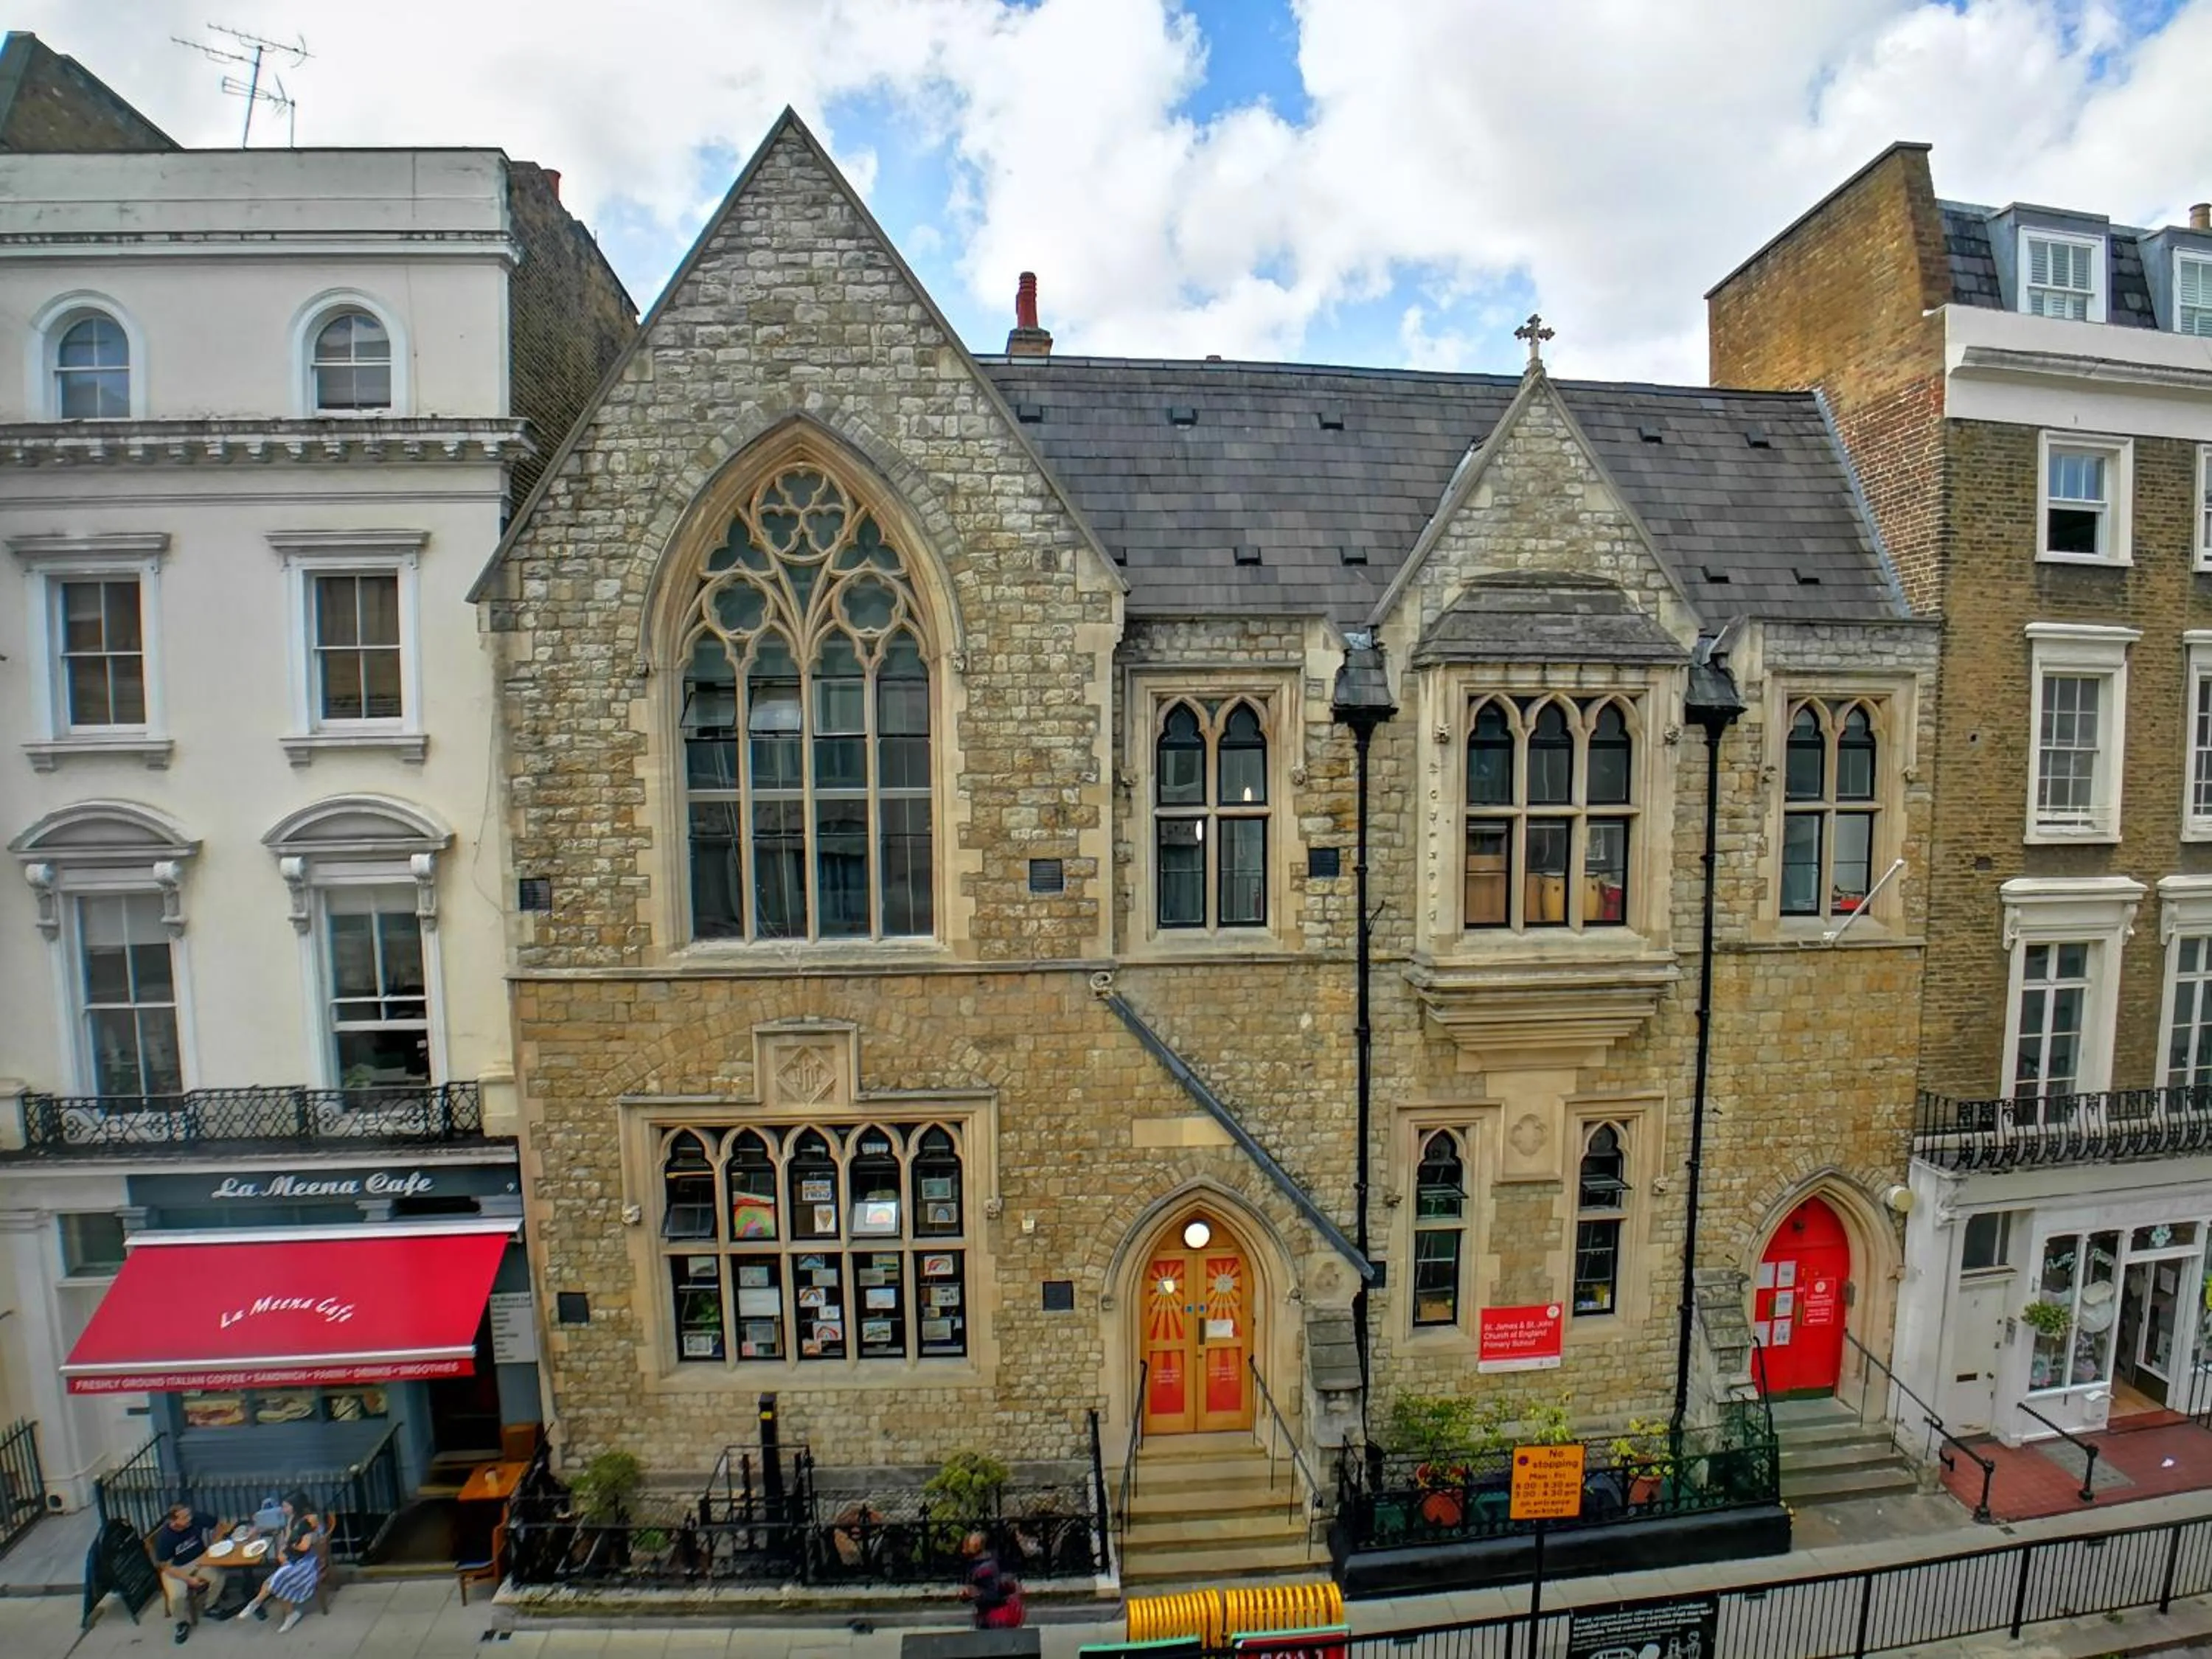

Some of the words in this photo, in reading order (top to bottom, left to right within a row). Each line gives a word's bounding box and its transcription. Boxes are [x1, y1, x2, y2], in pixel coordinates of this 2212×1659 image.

[212, 1178, 259, 1198] La
[260, 1175, 358, 1197] Meena
[365, 1171, 434, 1196] Cafe
[220, 1310, 246, 1328] La
[249, 1295, 316, 1317] Meena
[315, 1296, 355, 1323] Cafe
[1494, 1322, 1517, 1331] James
[1519, 1321, 1526, 1329] &
[1484, 1331, 1509, 1340] Church
[1509, 1330, 1517, 1338] of
[1518, 1329, 1547, 1339] England
[1484, 1340, 1510, 1350] Primary
[1512, 1338, 1536, 1347] School
[76, 1377, 119, 1391] FRESHLY
[121, 1376, 165, 1389] GROUND
[166, 1374, 205, 1387] ITALIAN
[206, 1372, 246, 1385] COFFEE
[1549, 1449, 1565, 1458] No
[1532, 1461, 1579, 1469] stopping
